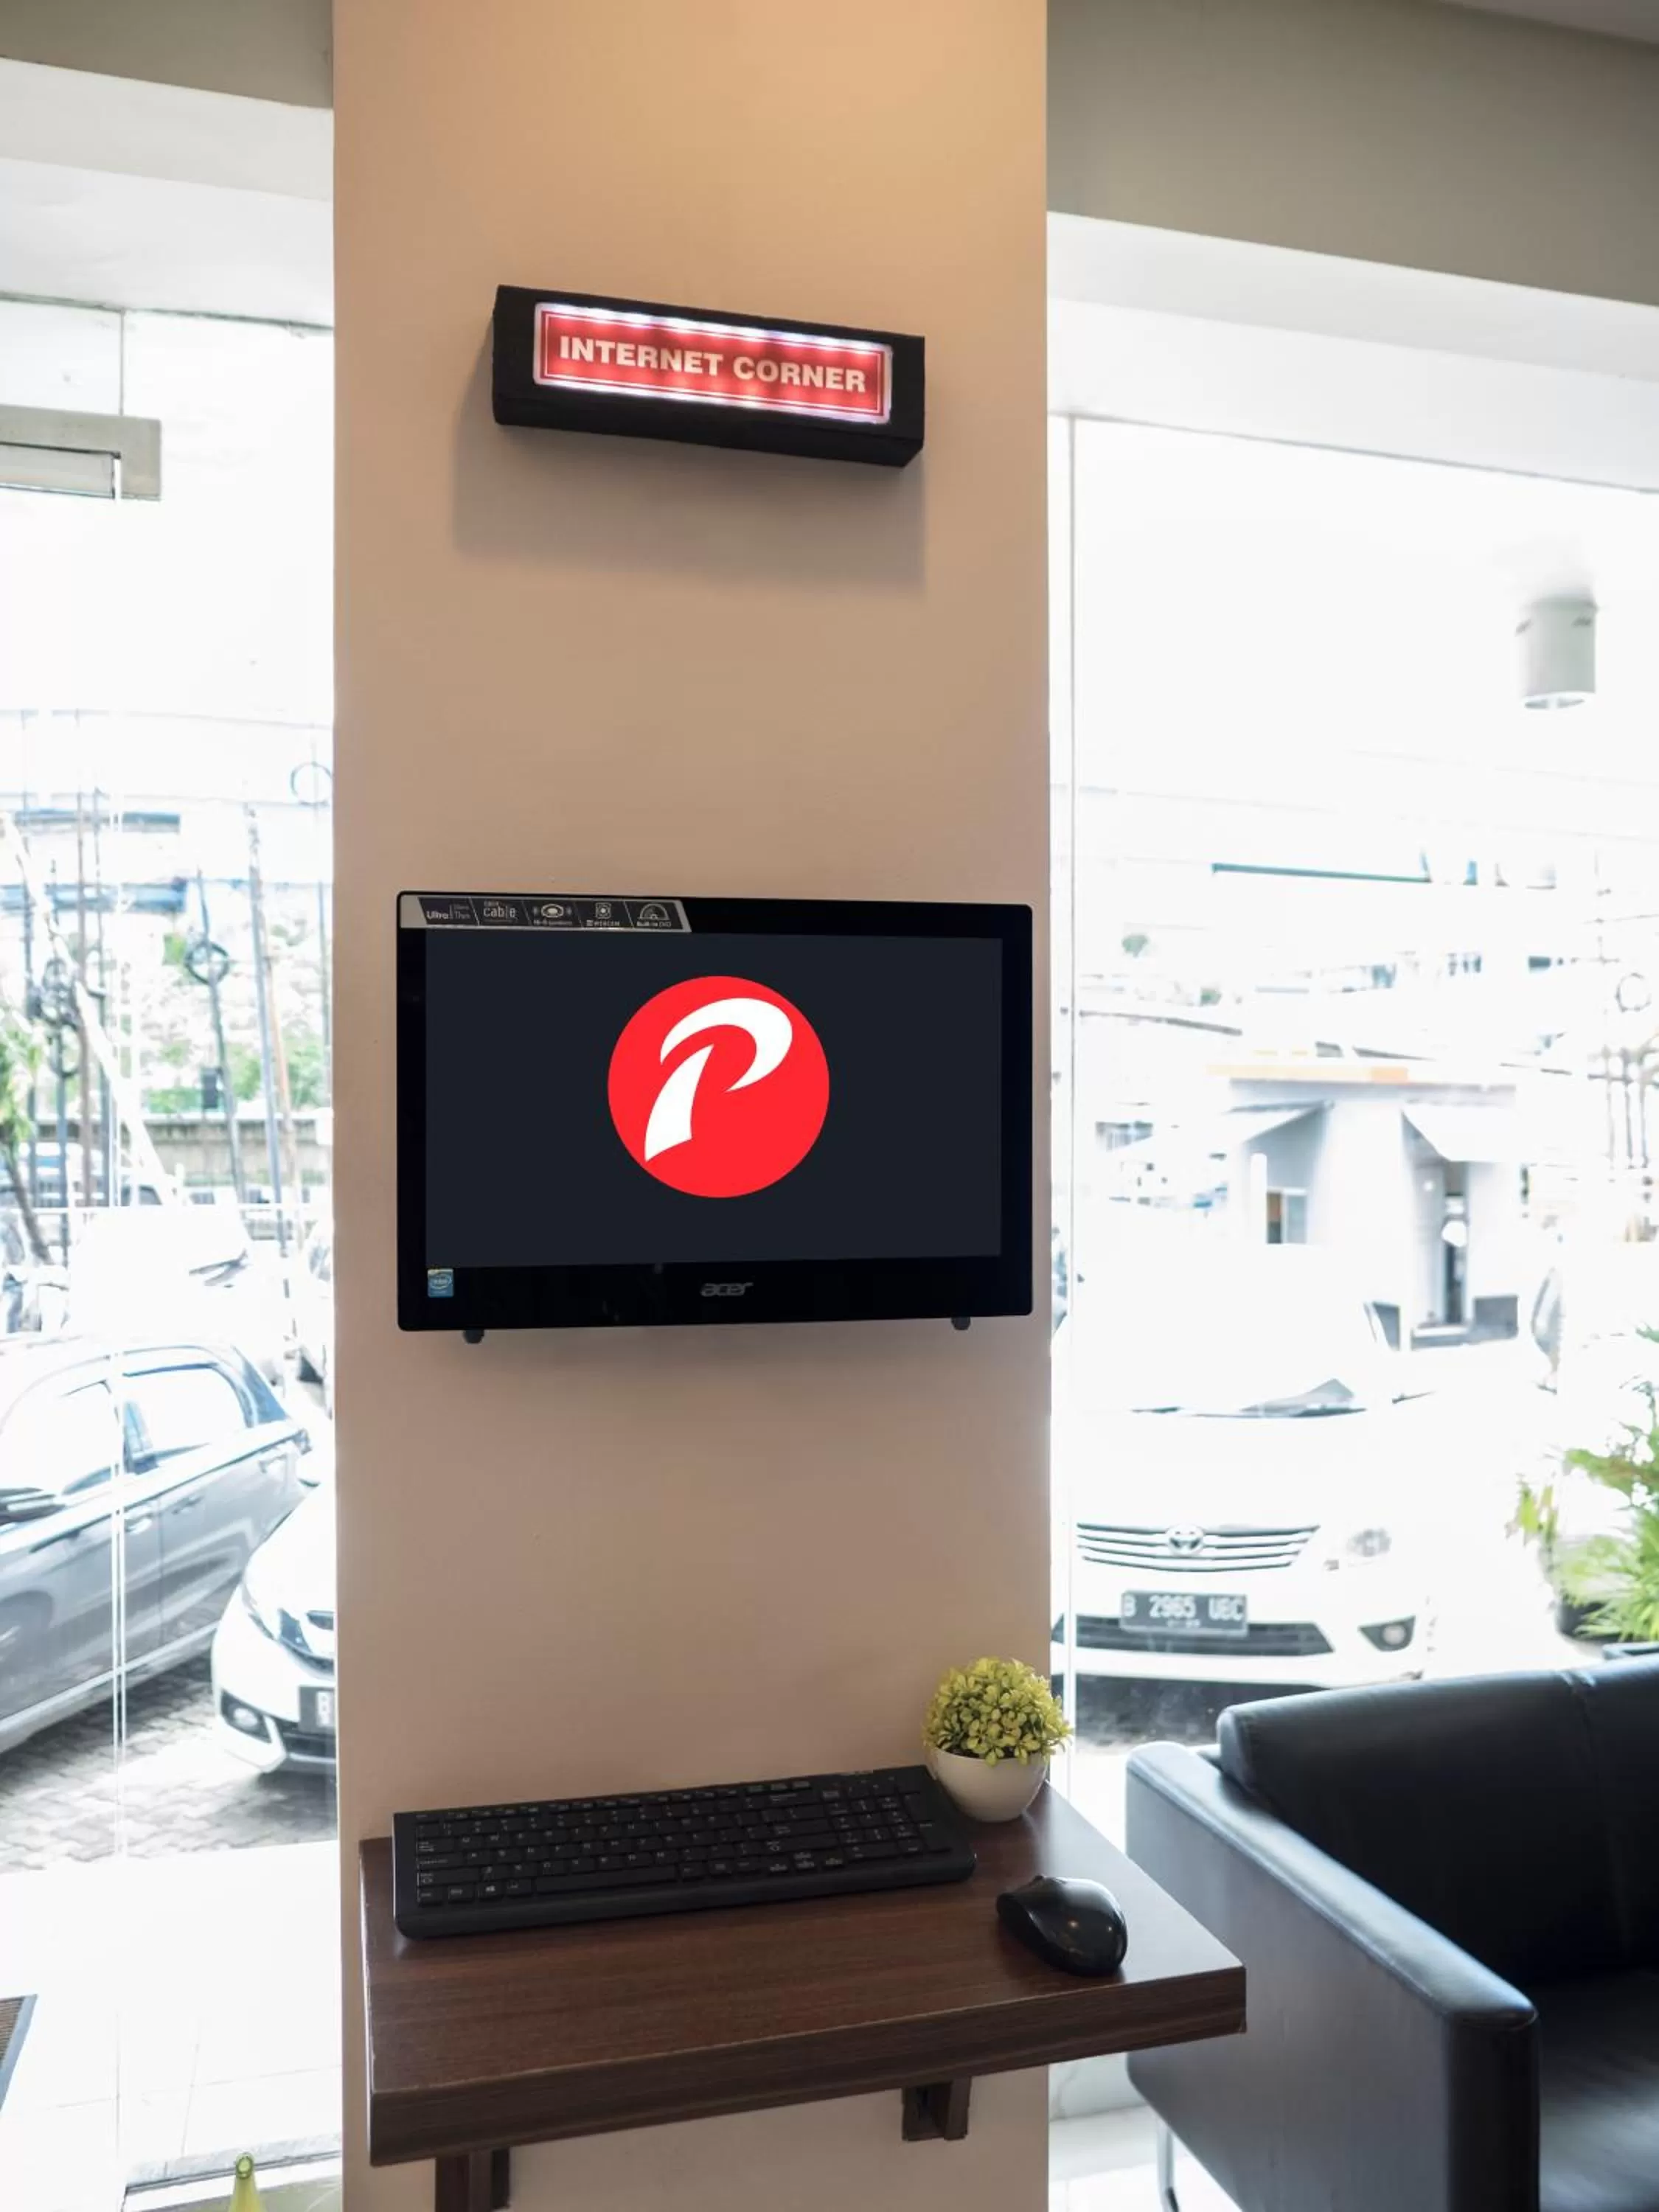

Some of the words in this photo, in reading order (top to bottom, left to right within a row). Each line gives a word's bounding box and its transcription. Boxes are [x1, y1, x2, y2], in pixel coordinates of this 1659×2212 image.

[560, 335, 723, 377] INTERNET
[733, 356, 866, 393] CORNER
[700, 1281, 754, 1298] acer
[1122, 1593, 1137, 1618] B
